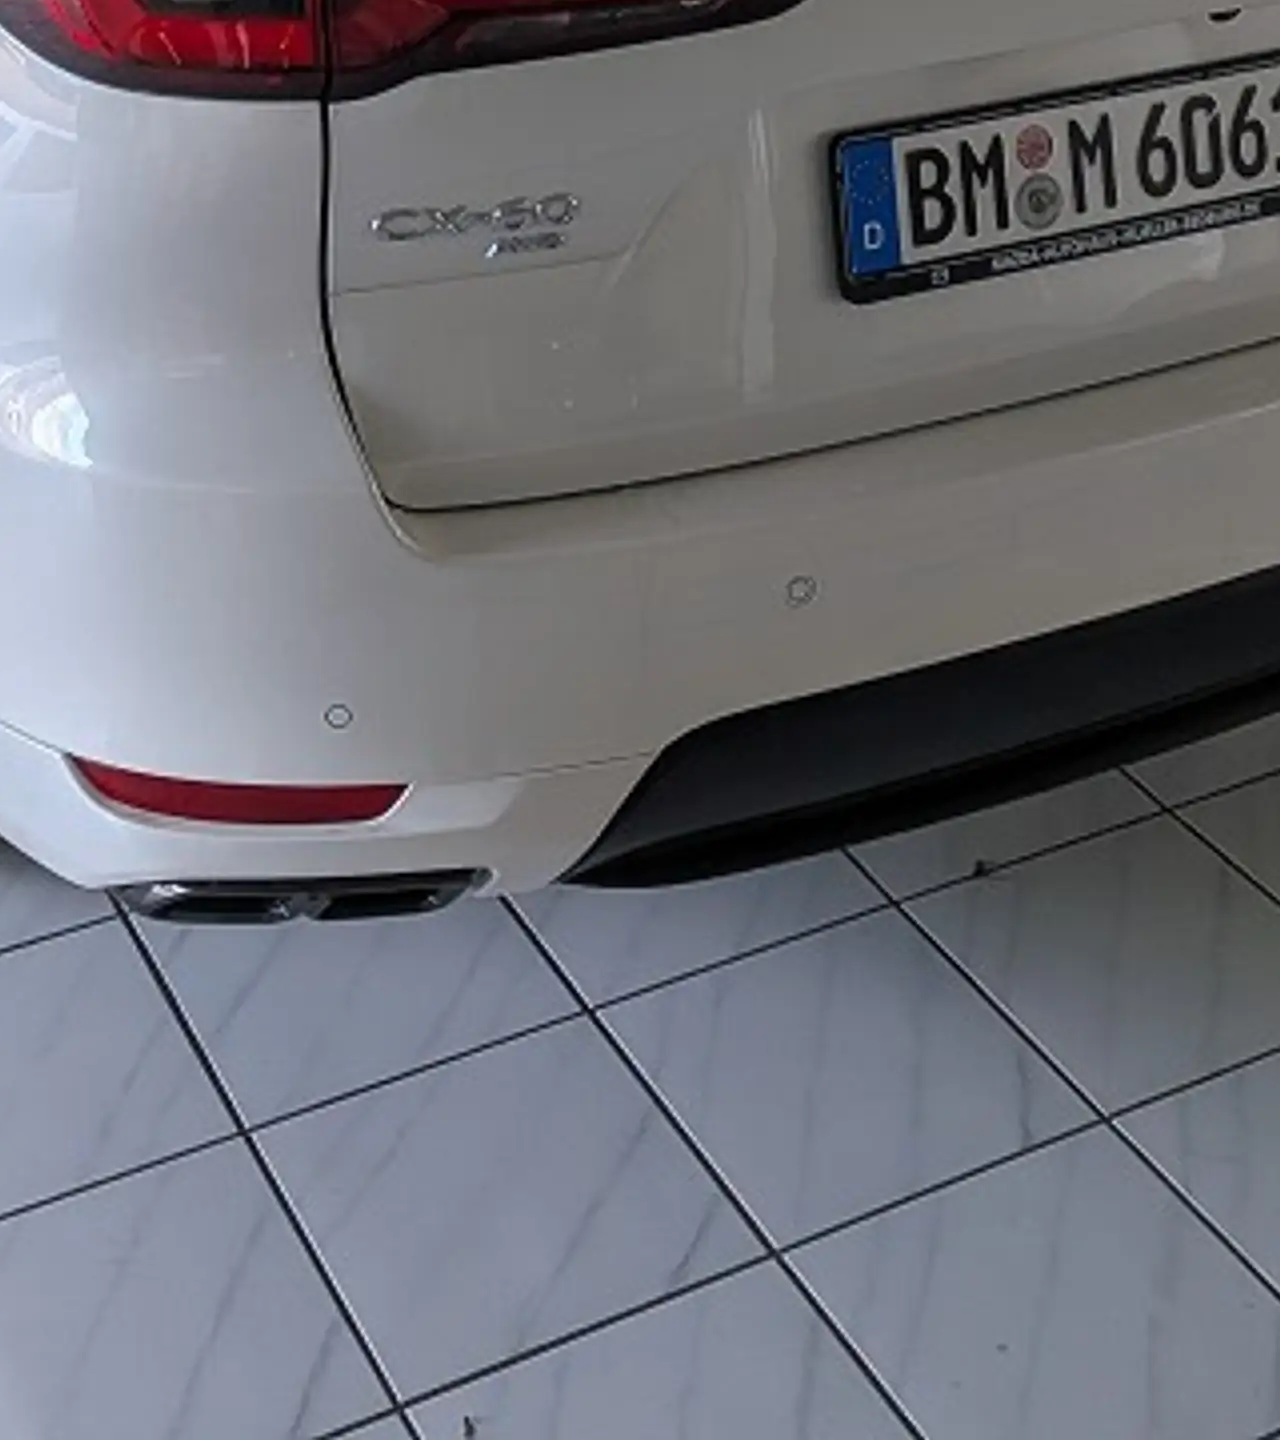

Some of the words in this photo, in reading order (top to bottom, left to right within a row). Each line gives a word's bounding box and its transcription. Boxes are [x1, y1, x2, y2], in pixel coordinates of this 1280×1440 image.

[904, 132, 1011, 248] BM
[1066, 111, 1119, 214] M
[863, 219, 886, 251] D
